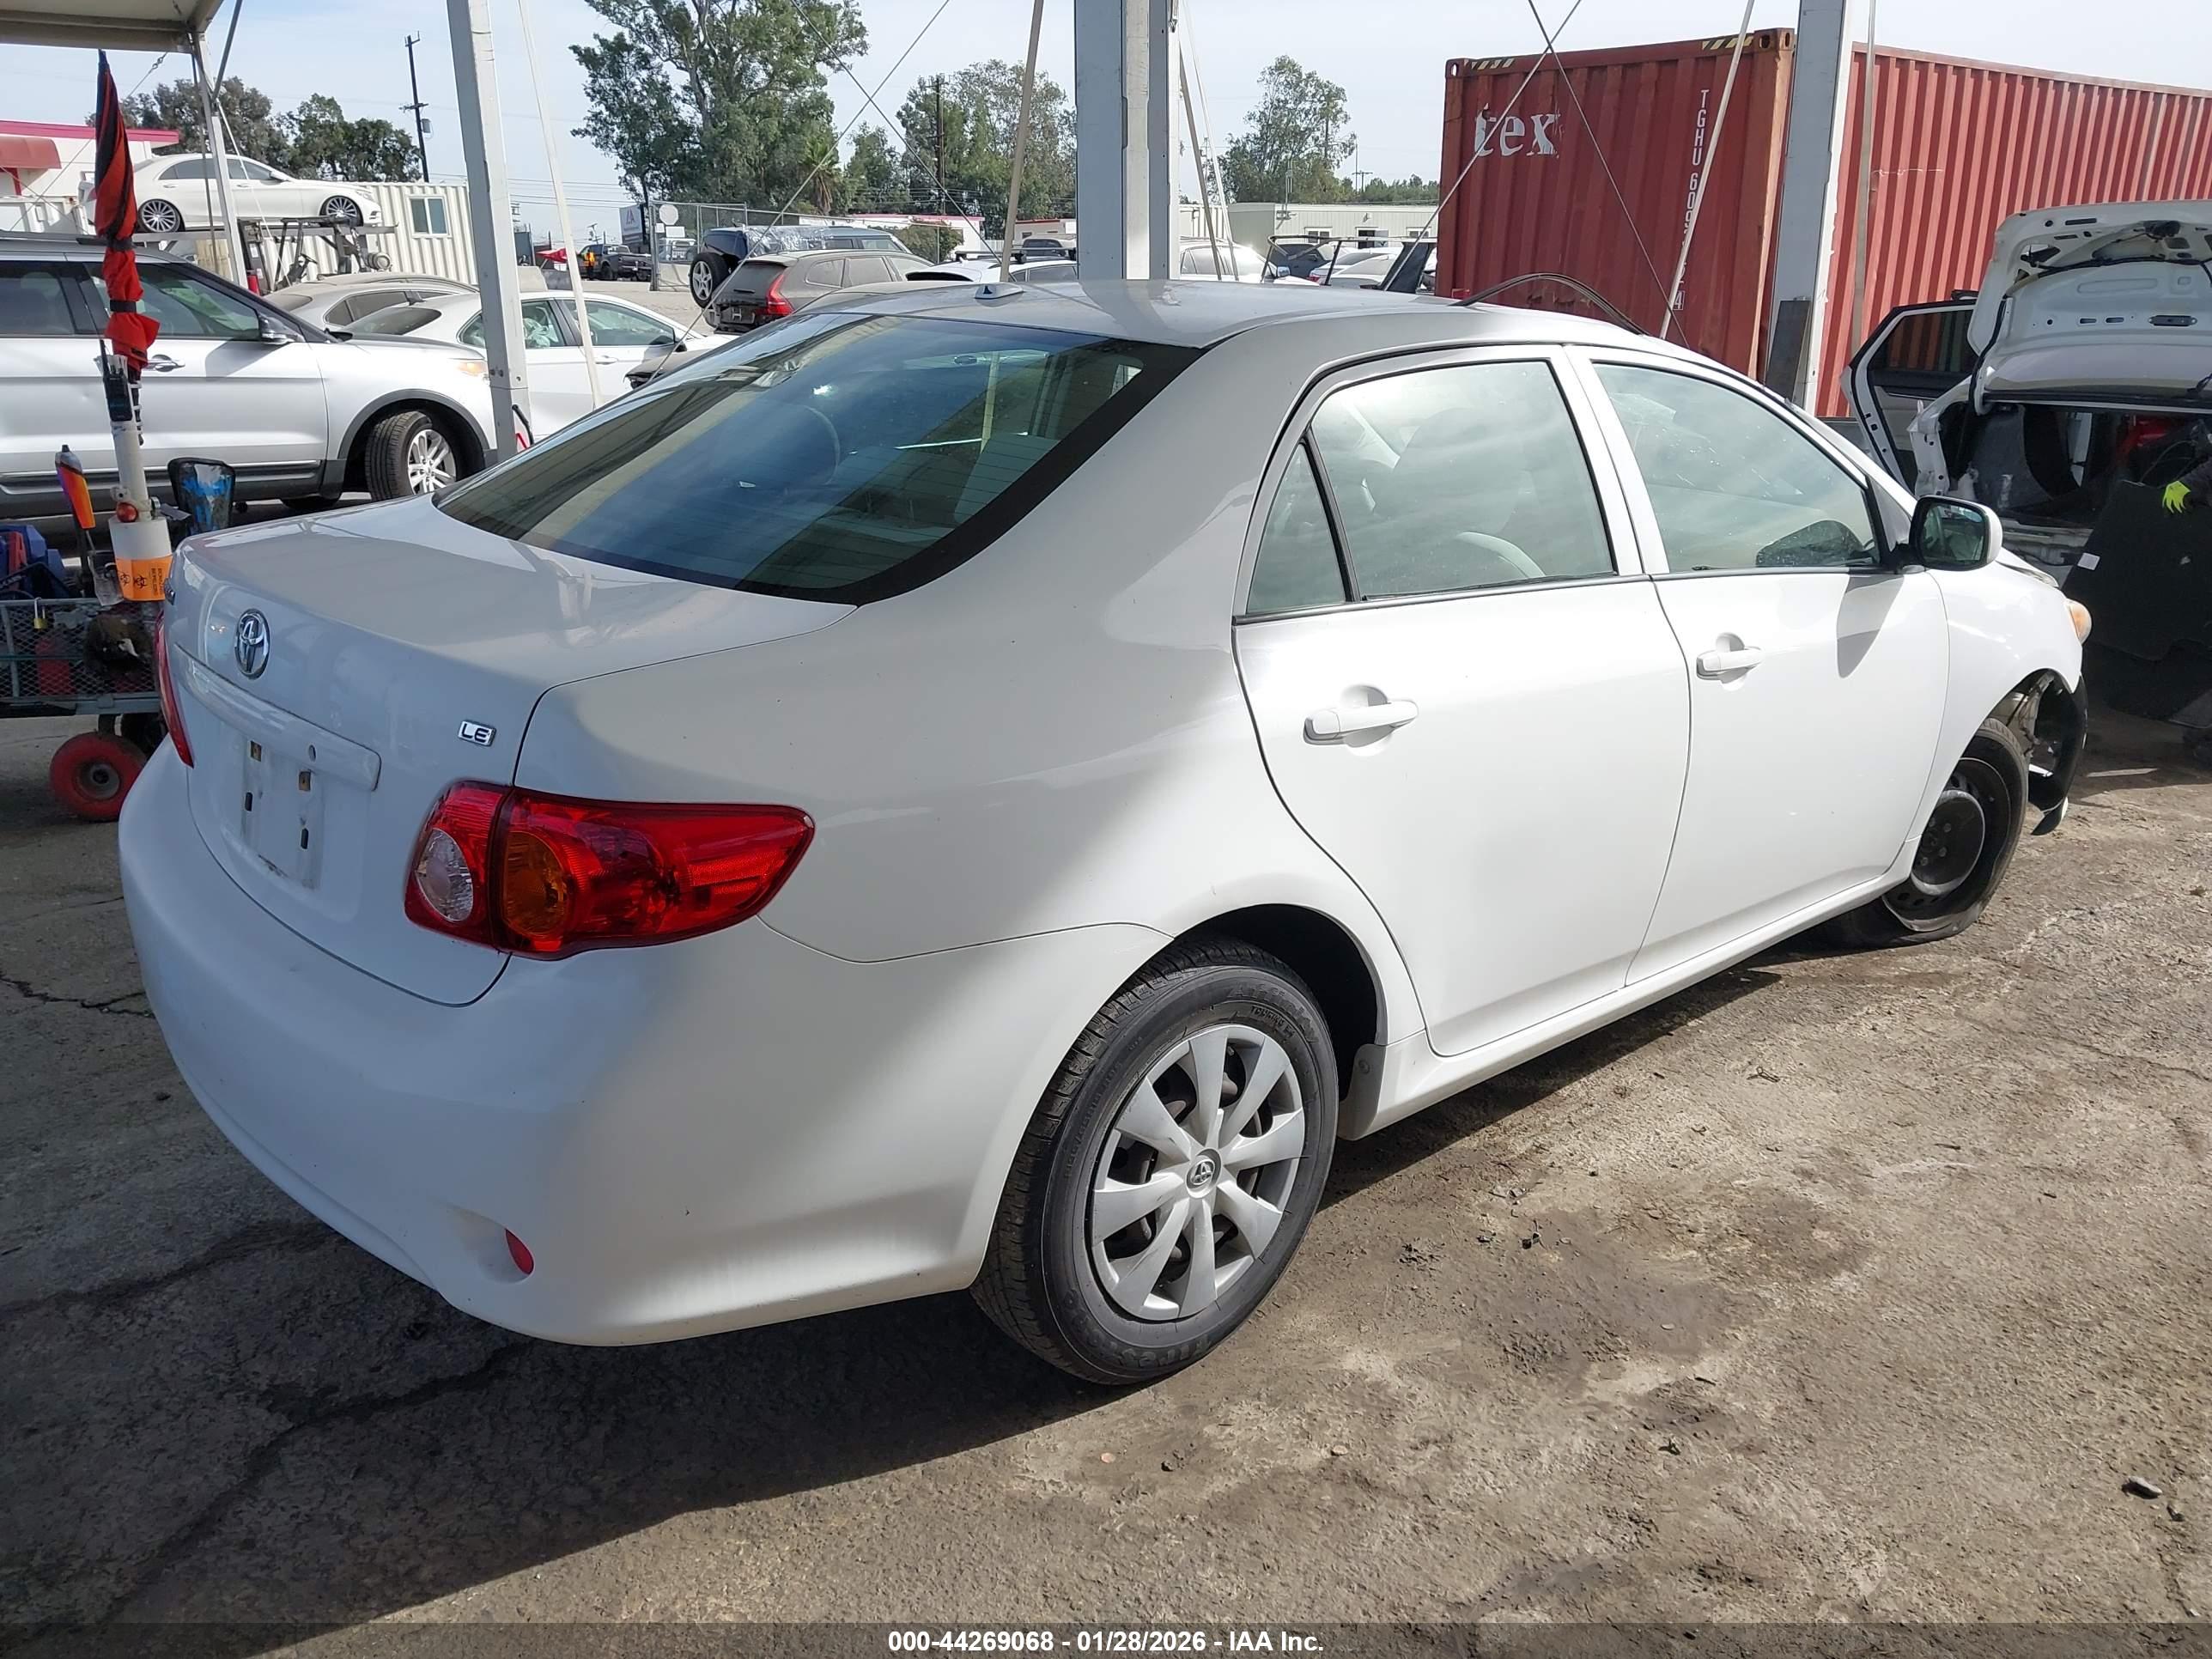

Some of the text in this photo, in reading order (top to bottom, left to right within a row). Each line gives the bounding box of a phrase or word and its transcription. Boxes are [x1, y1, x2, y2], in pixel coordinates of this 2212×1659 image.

[1474, 102, 1561, 157] tex
[1692, 89, 1710, 166] TGHU
[461, 722, 490, 744] LE
